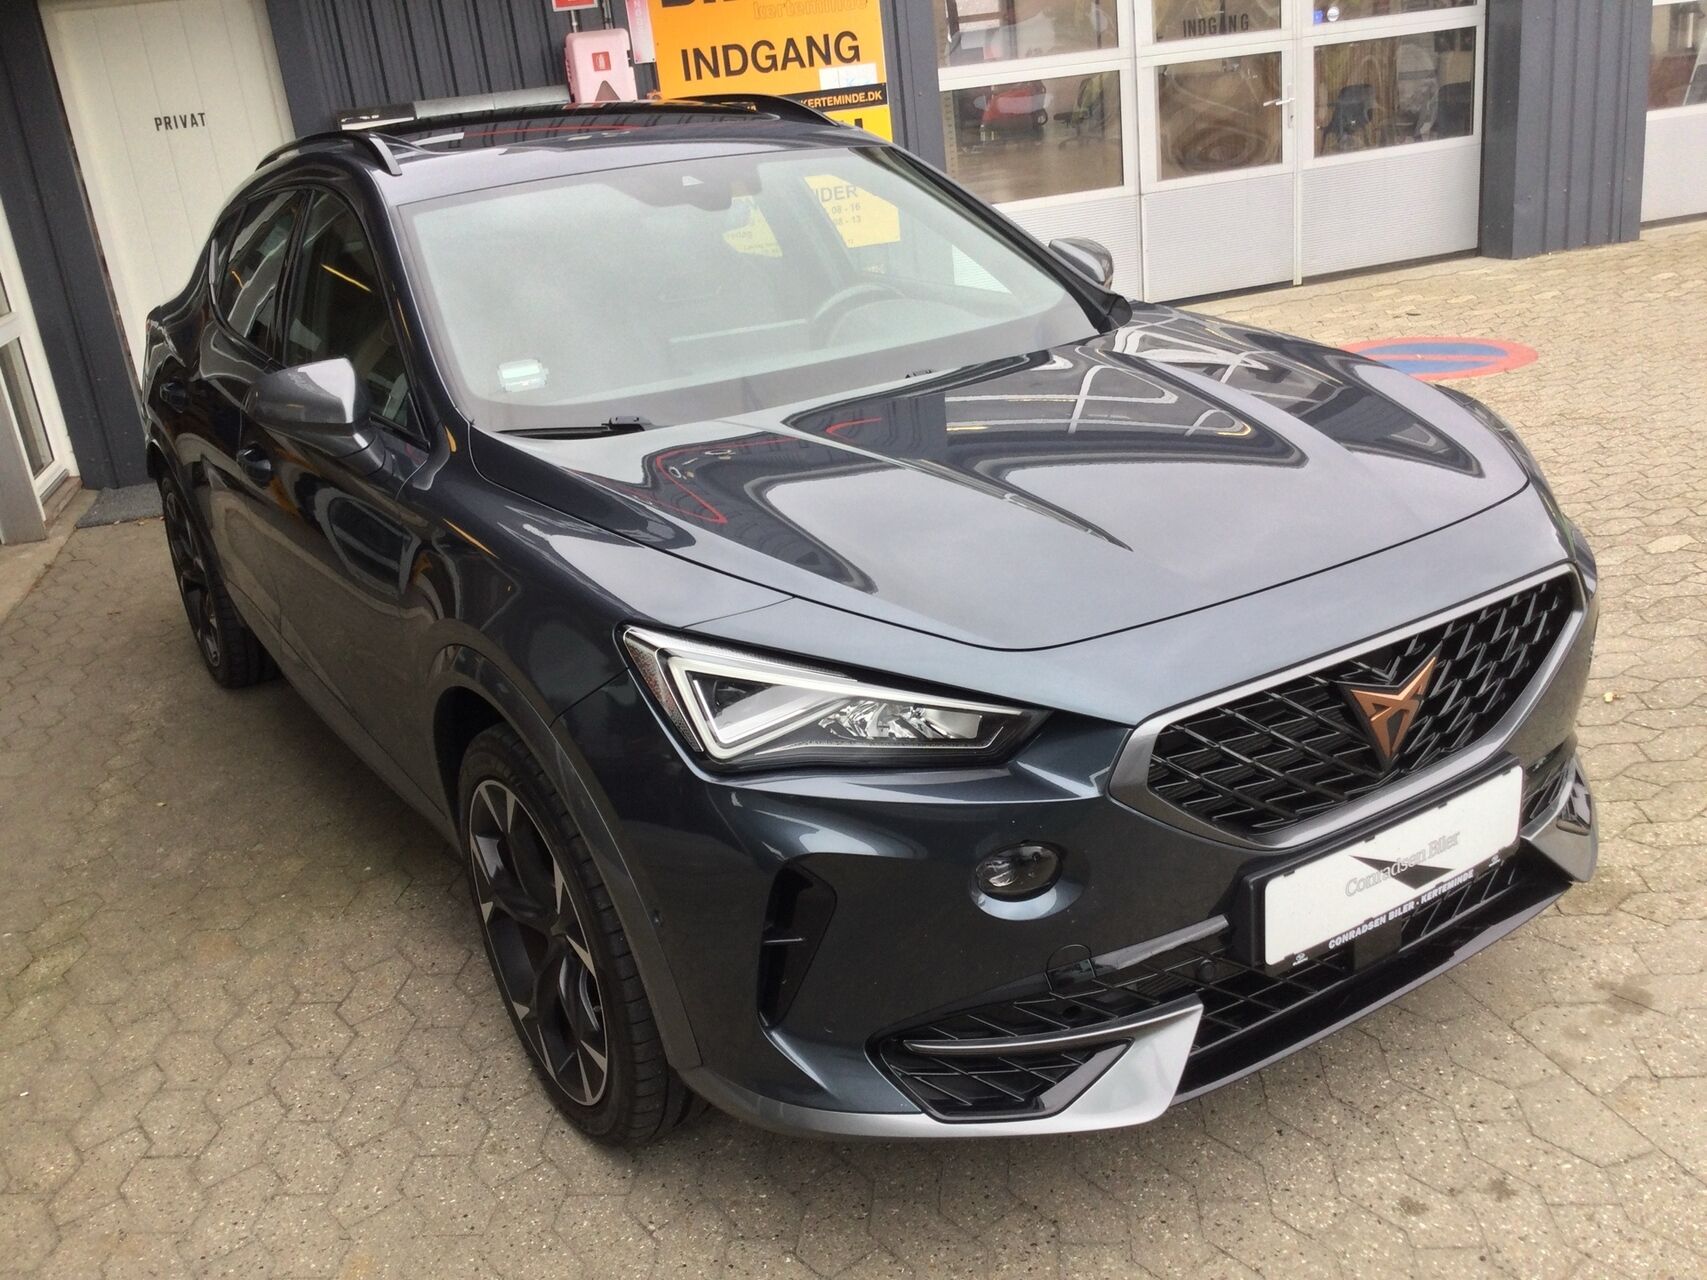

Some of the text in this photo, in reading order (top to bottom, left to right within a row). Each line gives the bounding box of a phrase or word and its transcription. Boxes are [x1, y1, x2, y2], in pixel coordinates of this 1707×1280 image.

[1183, 13, 1249, 38] INDGANG
[681, 31, 861, 82] INDGANG
[154, 112, 206, 131] PRIVAT
[1345, 832, 1460, 897] Conradsen Biler
[1328, 915, 1387, 949] CONRADSEN
[1388, 901, 1415, 921] BILER
[1421, 869, 1474, 903] KERTEMINDE
